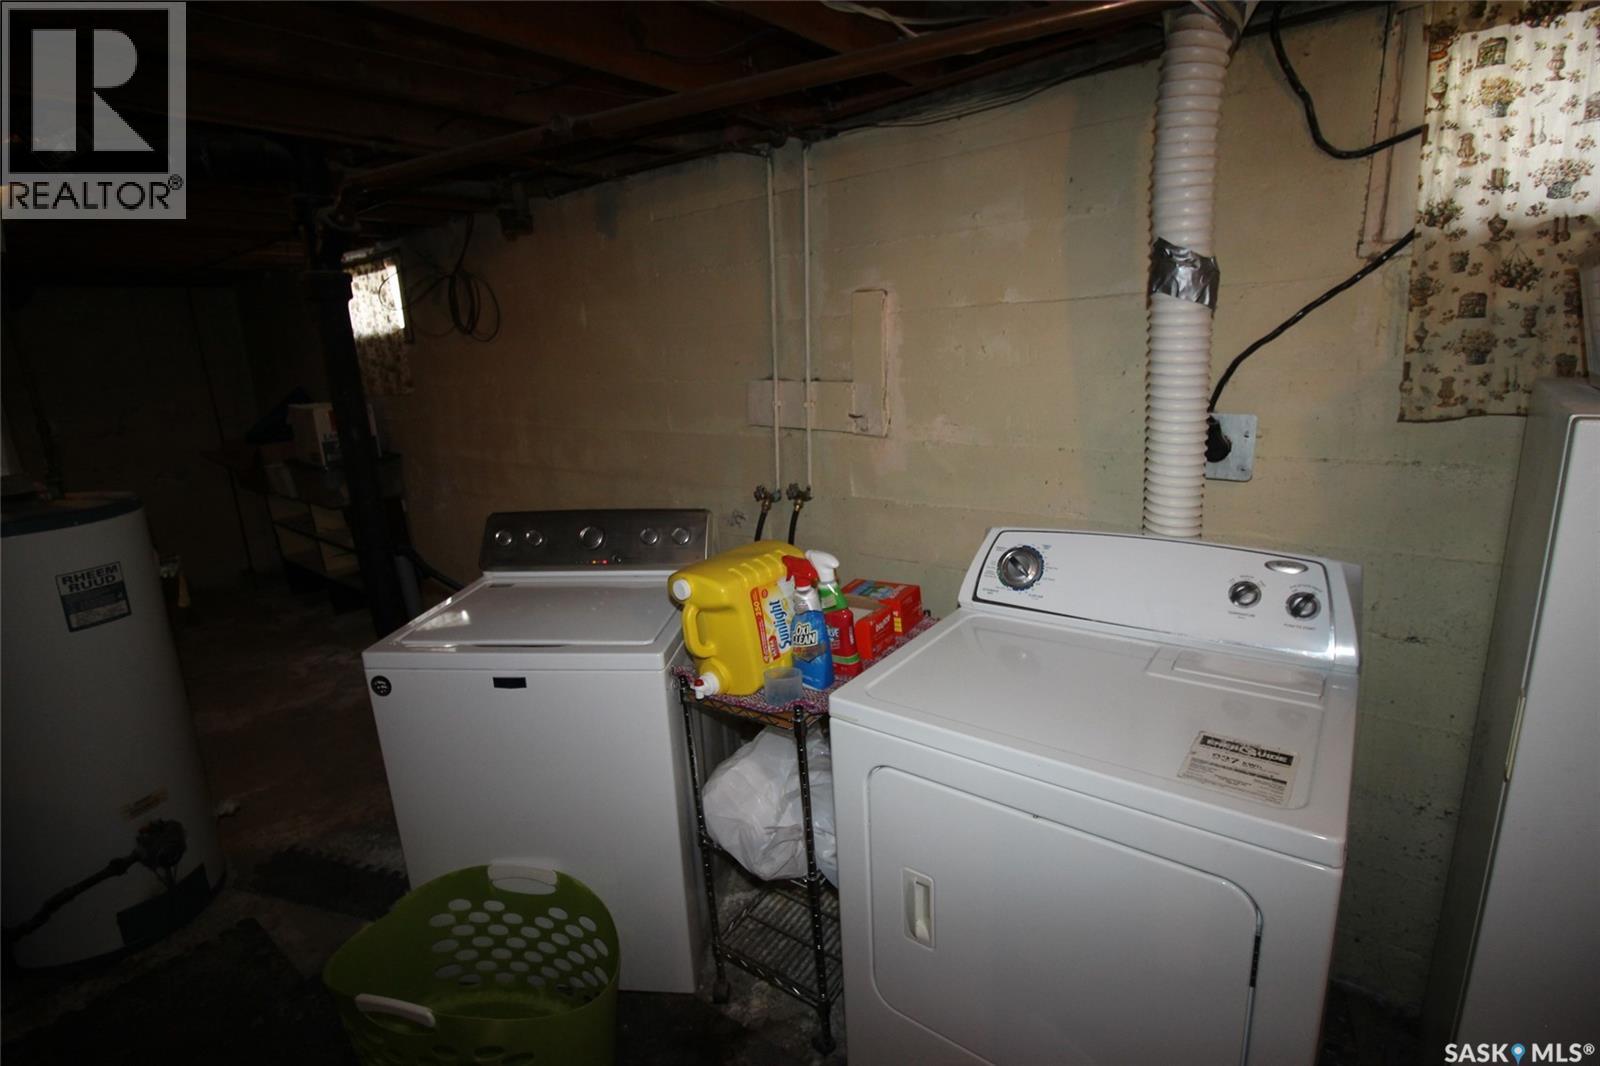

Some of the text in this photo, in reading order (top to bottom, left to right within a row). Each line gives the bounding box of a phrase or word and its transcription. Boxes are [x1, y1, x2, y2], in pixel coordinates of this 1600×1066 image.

[62, 565, 118, 585] RHEEM
[69, 575, 116, 592] RUUD
[769, 600, 792, 649] Sunlight
